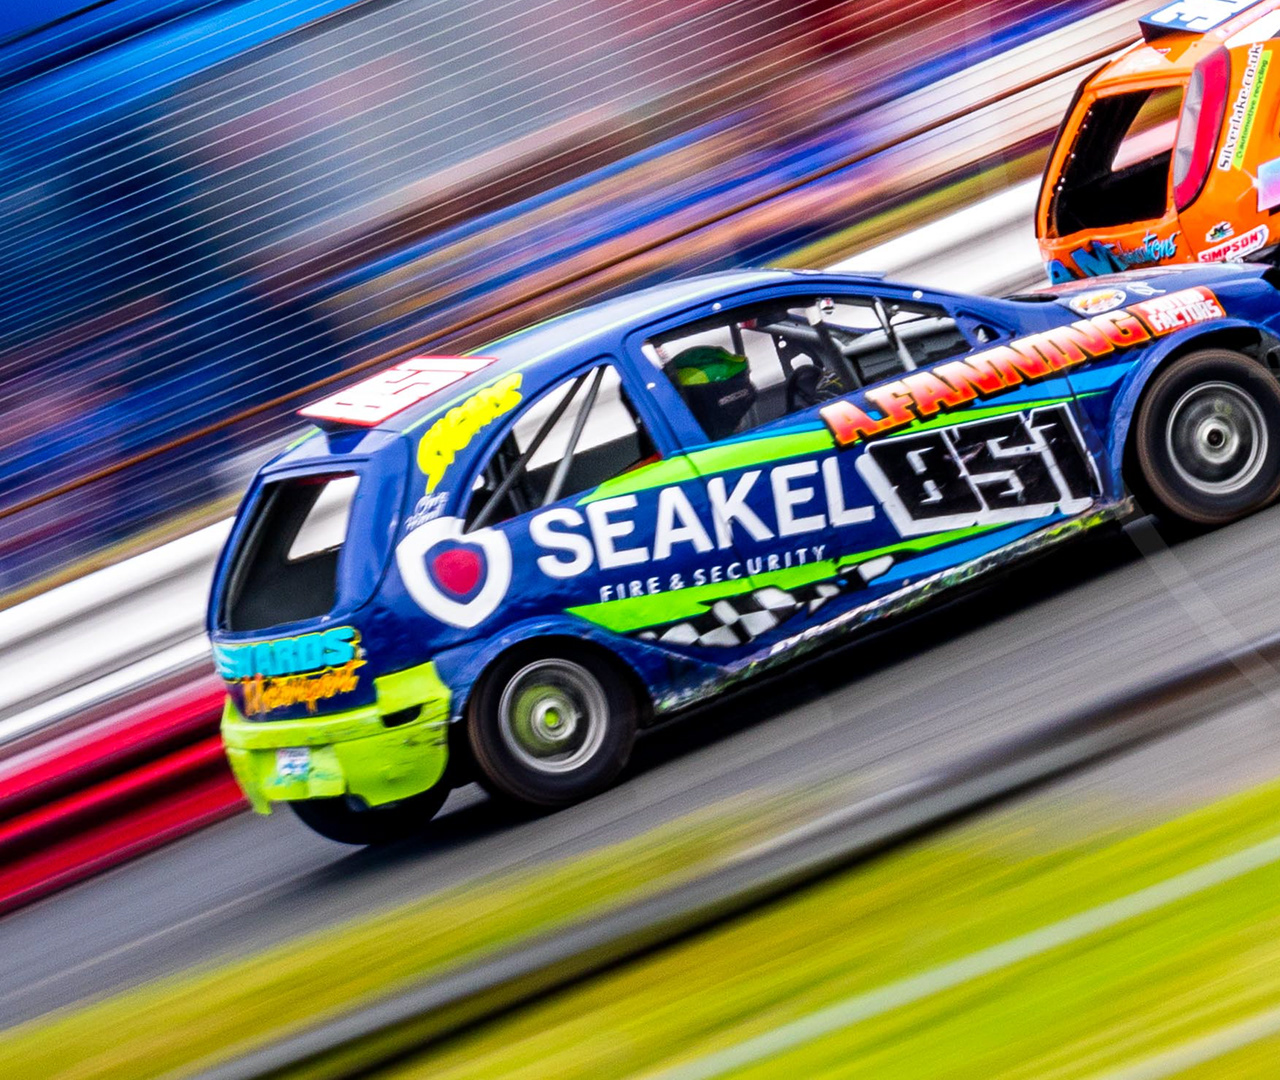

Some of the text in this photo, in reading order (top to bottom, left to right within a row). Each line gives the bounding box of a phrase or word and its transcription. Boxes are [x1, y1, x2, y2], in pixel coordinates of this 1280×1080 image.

[1217, 42, 1264, 171] Silverlake.co.uk
[1238, 98, 1257, 150] automotive
[1200, 230, 1260, 262] SIMPSON
[1148, 298, 1224, 332] FACTORS
[528, 455, 876, 579] SEAKEL
[600, 544, 827, 604] FIRE & SECURITY
